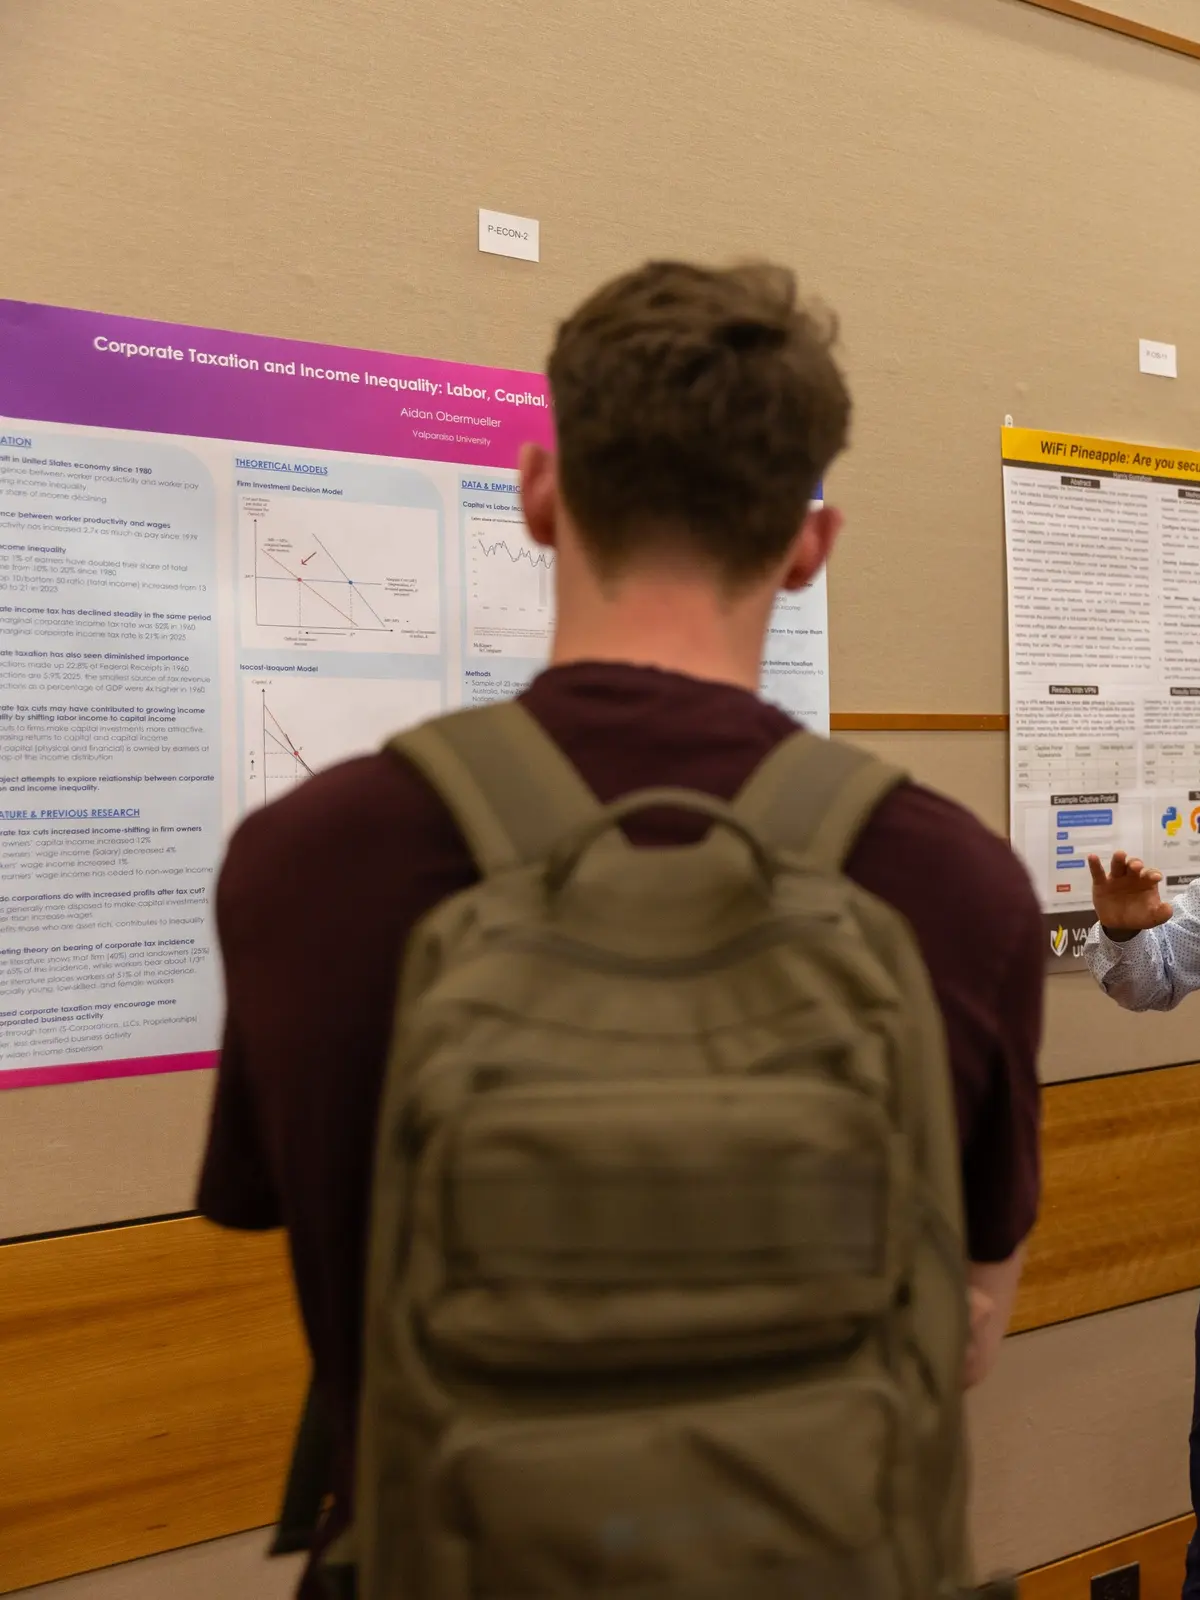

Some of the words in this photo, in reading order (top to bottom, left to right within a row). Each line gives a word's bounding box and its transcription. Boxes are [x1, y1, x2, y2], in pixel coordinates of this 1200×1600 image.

[488, 225, 528, 240] P-ECON-2
[94, 336, 184, 361] Corporate
[188, 348, 259, 371] Taxation
[264, 361, 296, 376] and
[300, 363, 360, 384] Income
[365, 371, 443, 396] Inequality:
[447, 382, 491, 401] Labor,
[495, 389, 549, 408] Capital,
[401, 407, 433, 420] Aidan
[436, 411, 501, 428] Obermueller
[412, 430, 454, 441] Valparaiso
[456, 434, 491, 447] University
[1040, 441, 1067, 457] WiFi
[1070, 445, 1129, 465] Pineapple:
[1133, 454, 1151, 466] Are
[1155, 457, 1174, 470] you
[22, 457, 47, 465] United
[74, 462, 110, 472] economy
[135, 467, 152, 475] 1980
[236, 458, 292, 471] THEORETICAL
[294, 464, 328, 475] MODELS
[237, 480, 251, 488] Firm
[253, 481, 290, 491] Investment
[292, 484, 320, 493] Decision
[322, 487, 343, 495] Model
[462, 480, 482, 488] DATA
[19, 511, 53, 520] between
[83, 517, 127, 526] productivity
[27, 545, 66, 554] inequality
[15, 606, 44, 614] income
[47, 607, 59, 615] tax
[61, 607, 75, 615] has
[78, 608, 111, 617] declined
[114, 610, 142, 619] steadily
[188, 613, 211, 622] period
[15, 650, 48, 658] taxation
[66, 651, 82, 659] also
[105, 652, 144, 660] diminished
[147, 653, 189, 663] importance
[1051, 686, 1071, 694] Results
[50, 706, 67, 715] may
[69, 705, 88, 713] have
[91, 705, 134, 713] contributed
[146, 707, 175, 715] growing
[178, 706, 205, 714] income
[15, 714, 25, 723] by
[27, 713, 54, 723] shifting
[79, 714, 108, 722] income
[120, 714, 146, 724] capital
[21, 775, 55, 784] attempts
[67, 775, 97, 784] explore
[99, 774, 142, 783] relationship
[144, 774, 176, 782] between
[179, 774, 214, 783] corporate
[10, 784, 24, 792] and
[60, 783, 99, 792] inequality.
[1079, 796, 1099, 804] Captive
[31, 810, 37, 818] &
[41, 809, 88, 818] PREVIOUS
[91, 808, 140, 817] RESEARCH
[33, 828, 49, 836] cuts
[51, 827, 90, 835] increased
[92, 826, 150, 836] income-shifting
[12, 892, 61, 903] corporations
[64, 892, 73, 900] do
[93, 890, 131, 898] increased
[133, 888, 155, 897] profits
[157, 888, 173, 896] after
[190, 887, 205, 895] cut?
[24, 945, 49, 955] theory
[63, 943, 93, 953] bearing
[96, 942, 103, 950] of
[105, 941, 142, 951] corporate
[158, 937, 195, 946] incidence
[20, 1007, 59, 1017] corporate
[61, 1003, 92, 1013] taxation
[95, 1002, 111, 1012] may
[114, 999, 155, 1010] encourage
[41, 1014, 74, 1024] business
[76, 1012, 104, 1022] activity
